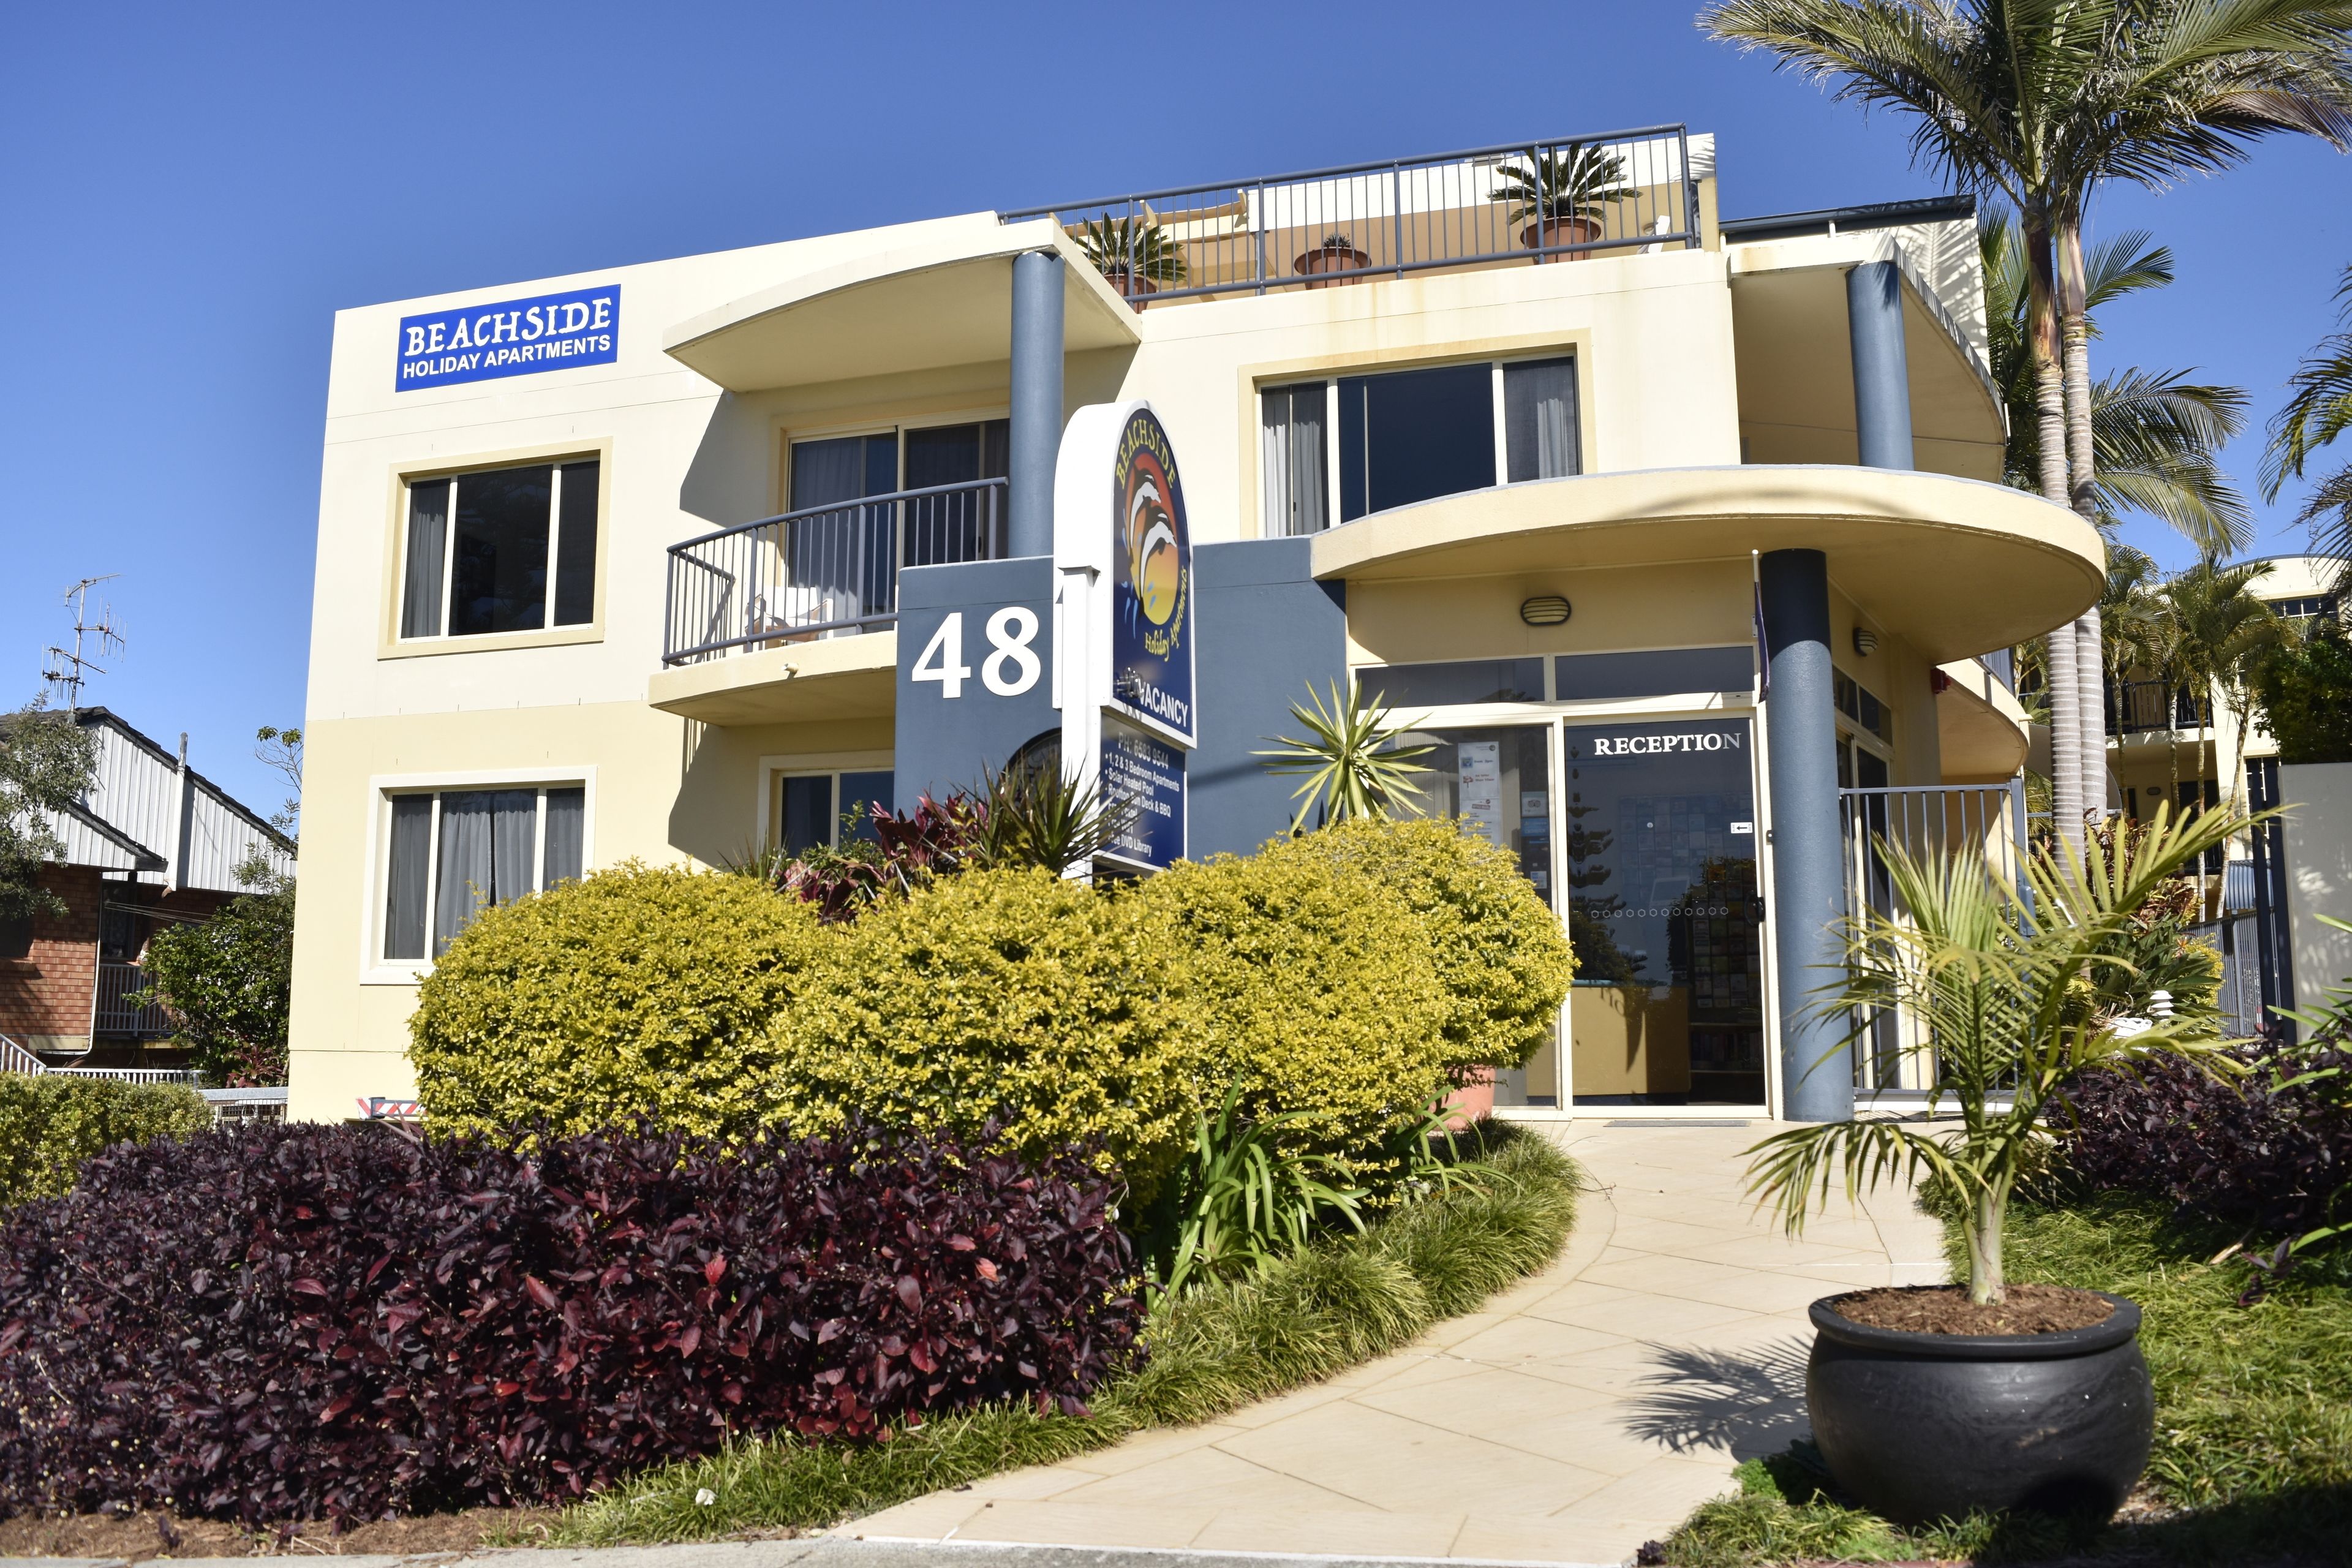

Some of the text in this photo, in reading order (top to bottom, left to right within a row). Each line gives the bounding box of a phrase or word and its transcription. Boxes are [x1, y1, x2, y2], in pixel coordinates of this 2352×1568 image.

[405, 297, 612, 356] BEACHSIDE
[403, 334, 611, 379] HOLIDAY APARTMENTS
[1116, 419, 1175, 489] BEACHSIDE
[1145, 565, 1187, 662] Holiday Apartments
[911, 606, 1041, 699] 48
[1137, 678, 1188, 728] VACANCY
[1118, 732, 1169, 770] PH: 6583 9544
[1594, 733, 1741, 755] RECEPTION
[1109, 767, 1154, 796] Solar Heated Pool
[1115, 755, 1119, 767] 2
[1120, 756, 1124, 769] &
[1125, 759, 1129, 771] 3
[1129, 761, 1152, 781] Bedroom
[1153, 771, 1180, 792] Apartments
[1141, 796, 1154, 812] Deck
[1155, 801, 1159, 813] &
[1159, 802, 1171, 818] BBQ
[1121, 834, 1133, 849] DVD
[1134, 837, 1152, 858] Library
